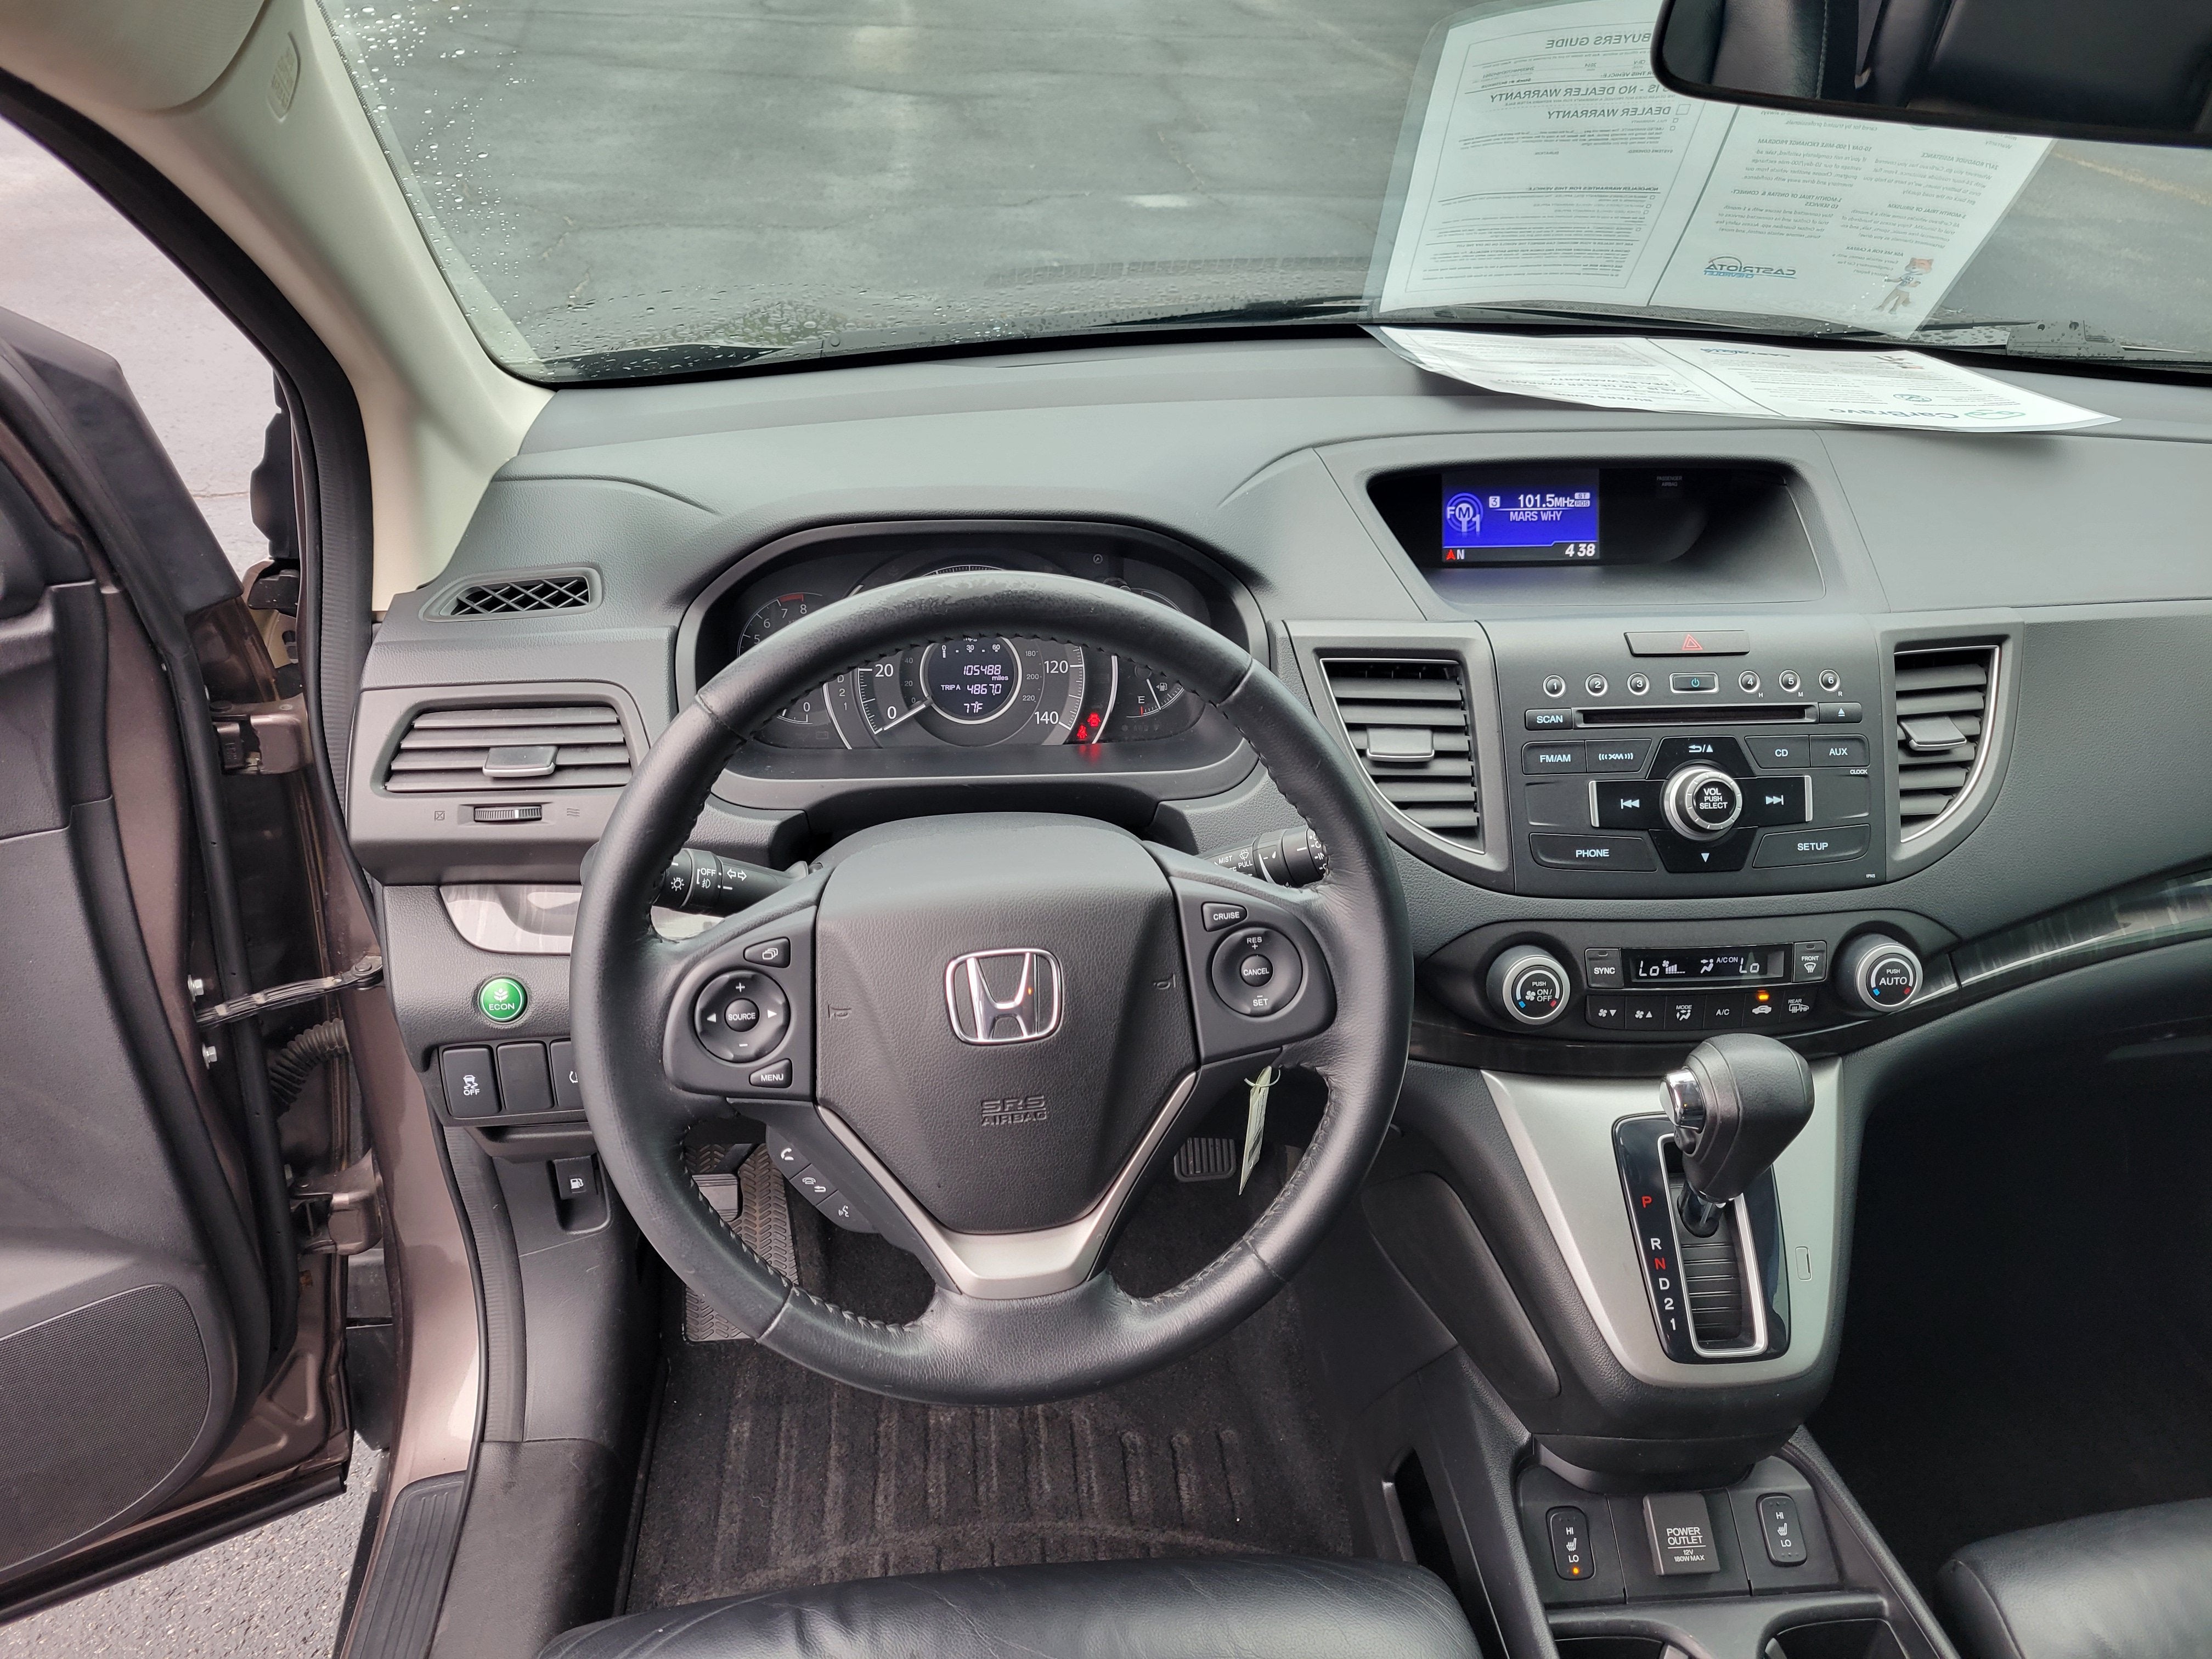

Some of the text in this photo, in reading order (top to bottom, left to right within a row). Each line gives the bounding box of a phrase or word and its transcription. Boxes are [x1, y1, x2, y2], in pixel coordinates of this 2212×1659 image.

[1829, 409, 1959, 419] CarBravo
[1518, 494, 1575, 508] 101.5MHz
[1510, 511, 1562, 521] MARS WHY
[1458, 550, 1465, 559] N
[781, 609, 787, 618] 7
[800, 605, 807, 614] 8
[764, 619, 770, 628] 6
[754, 635, 760, 644] 5
[876, 664, 893, 677] 20
[964, 665, 1001, 675] 105488
[1045, 661, 1068, 673] 120
[804, 702, 810, 712] 0
[888, 706, 896, 719] 0
[1035, 712, 1059, 724] 140
[1540, 754, 1571, 763] FM/AM
[1576, 849, 1609, 857] PHONE
[1218, 855, 1233, 864] MIST
[701, 868, 716, 876] OFF
[1214, 912, 1239, 920] CRUISE
[1243, 968, 1269, 976] CANCEL
[1879, 977, 1907, 985] AUTO
[981, 1096, 1047, 1113] SRS
[981, 1112, 1047, 1126] AIRBAG
[1642, 1196, 1651, 1207] P
[1651, 1238, 1662, 1250] R
[1655, 1258, 1666, 1269] N
[1659, 1278, 1669, 1290] D
[1664, 1298, 1674, 1310] 2
[1671, 1318, 1675, 1330] 1
[1667, 1527, 1701, 1536] POWER
[1667, 1536, 1702, 1545] OUTLET
